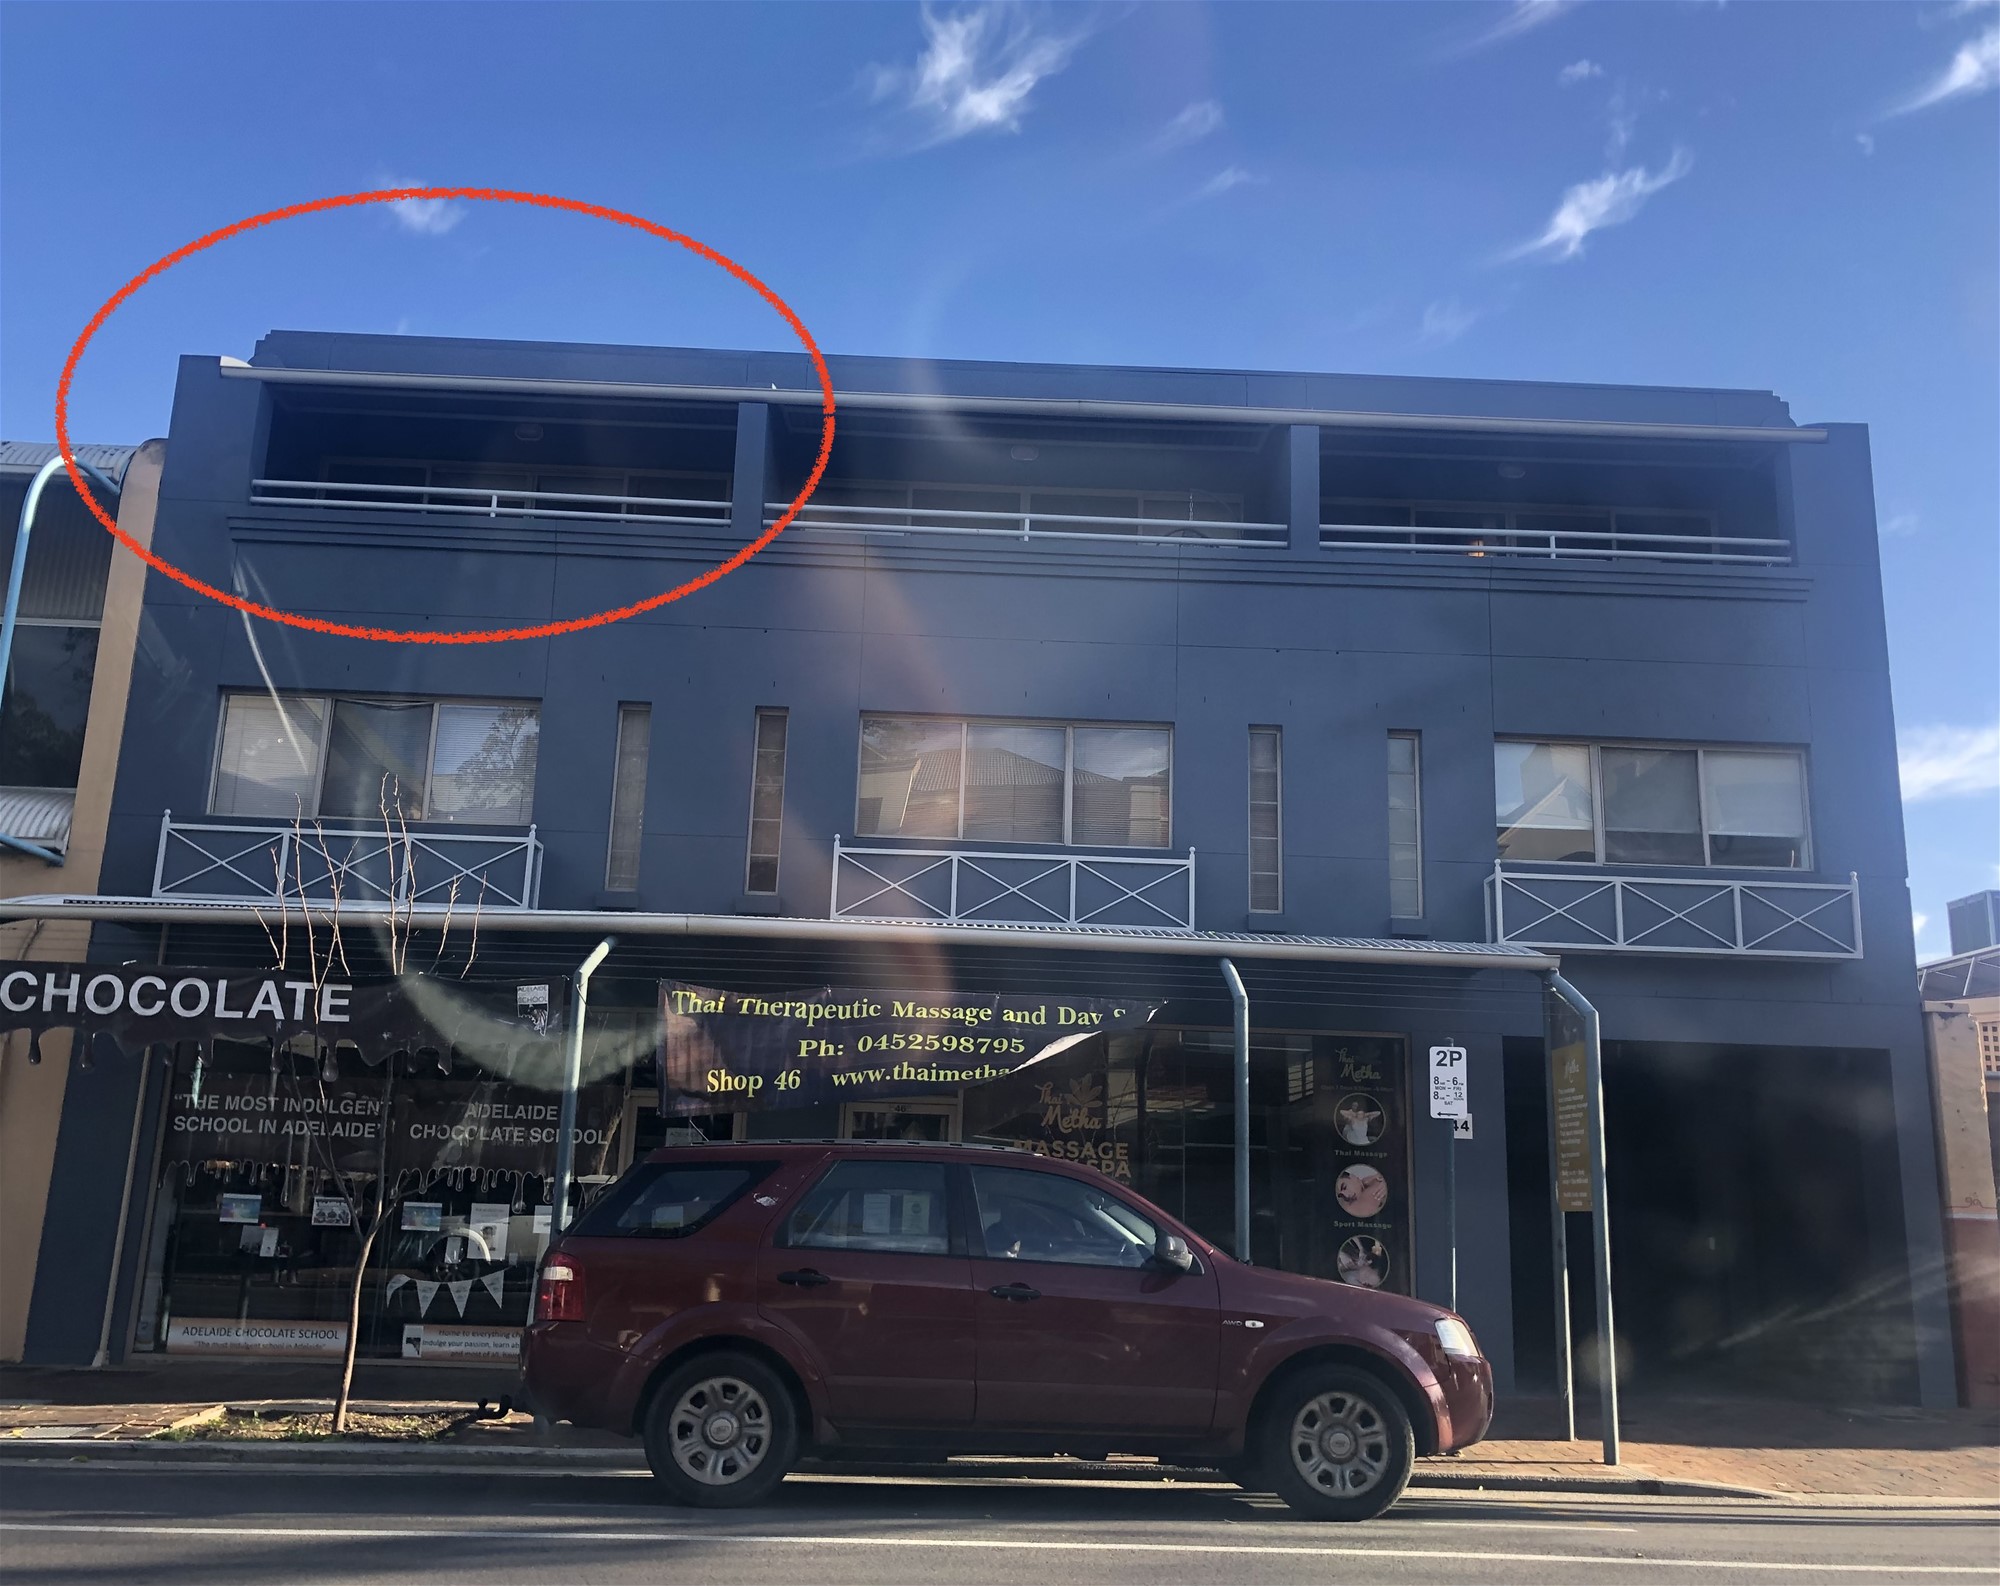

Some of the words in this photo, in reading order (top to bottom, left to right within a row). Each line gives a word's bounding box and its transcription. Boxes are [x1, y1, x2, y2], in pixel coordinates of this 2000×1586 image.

[0, 971, 353, 1022] CHOCOLATE
[672, 990, 725, 1016] Thai
[737, 998, 881, 1028] Therapeutic
[891, 1001, 992, 1026] Massage
[1003, 1005, 1047, 1026] and
[797, 1039, 844, 1057] Ph:
[857, 1033, 1026, 1054] 0452598795
[1436, 1050, 1463, 1067] 2P
[1340, 1063, 1381, 1082] Metha
[1433, 1076, 1440, 1085] 8
[1452, 1076, 1459, 1086] 6
[706, 1068, 764, 1098] Shop
[773, 1069, 801, 1091] 46
[1034, 1081, 1063, 1105] Thai
[1433, 1091, 1440, 1100] 8
[225, 1095, 279, 1112] MOST
[464, 1102, 558, 1121] ADELAIDE
[173, 1116, 253, 1134] SCHOOL
[258, 1119, 277, 1135] IN
[1041, 1105, 1103, 1134] Metha
[409, 1123, 525, 1142] CHOCOLATE
[1013, 1139, 1129, 1160] MASSAGE
[1354, 1149, 1388, 1159] Massage
[1333, 1220, 1355, 1229] Sport
[1357, 1221, 1392, 1230] Massage
[182, 1326, 232, 1337] ADELAIDE
[235, 1327, 296, 1339] CHOCOLATE
[298, 1328, 340, 1340] SCHOOL
[471, 1330, 511, 1339] everything
[229, 1341, 261, 1350] indulgent
[422, 1340, 447, 1348] Indulge
